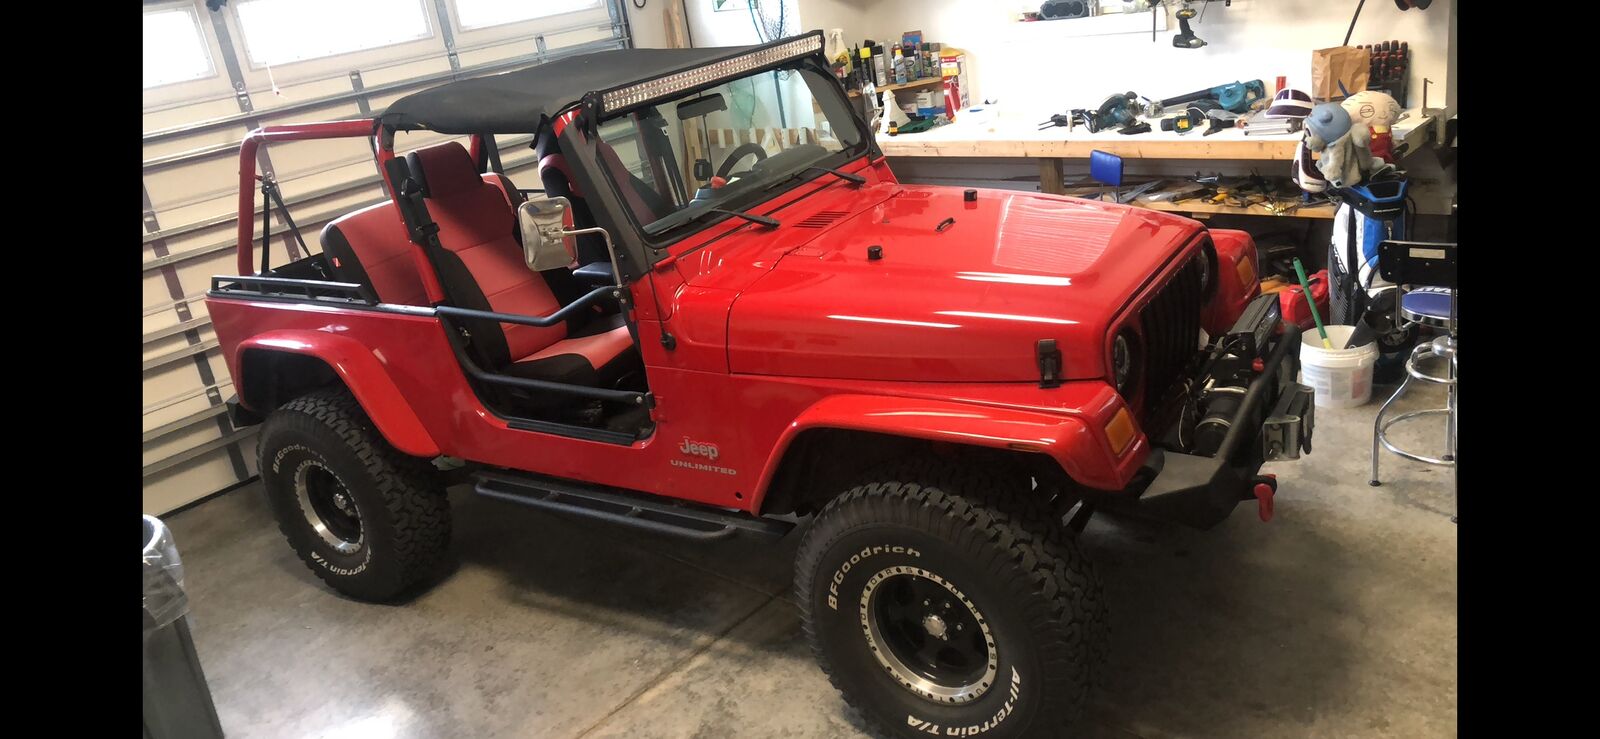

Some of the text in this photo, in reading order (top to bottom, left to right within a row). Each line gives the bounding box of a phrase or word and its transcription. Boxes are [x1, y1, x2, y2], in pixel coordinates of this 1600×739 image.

[272, 443, 327, 474] BFGoodrich
[680, 438, 719, 460] Jeep
[670, 459, 737, 476] UNLIMITED
[311, 551, 328, 569] T/A
[828, 544, 921, 611] BFGoodrich
[907, 664, 1021, 738] All-Terrain T/A
